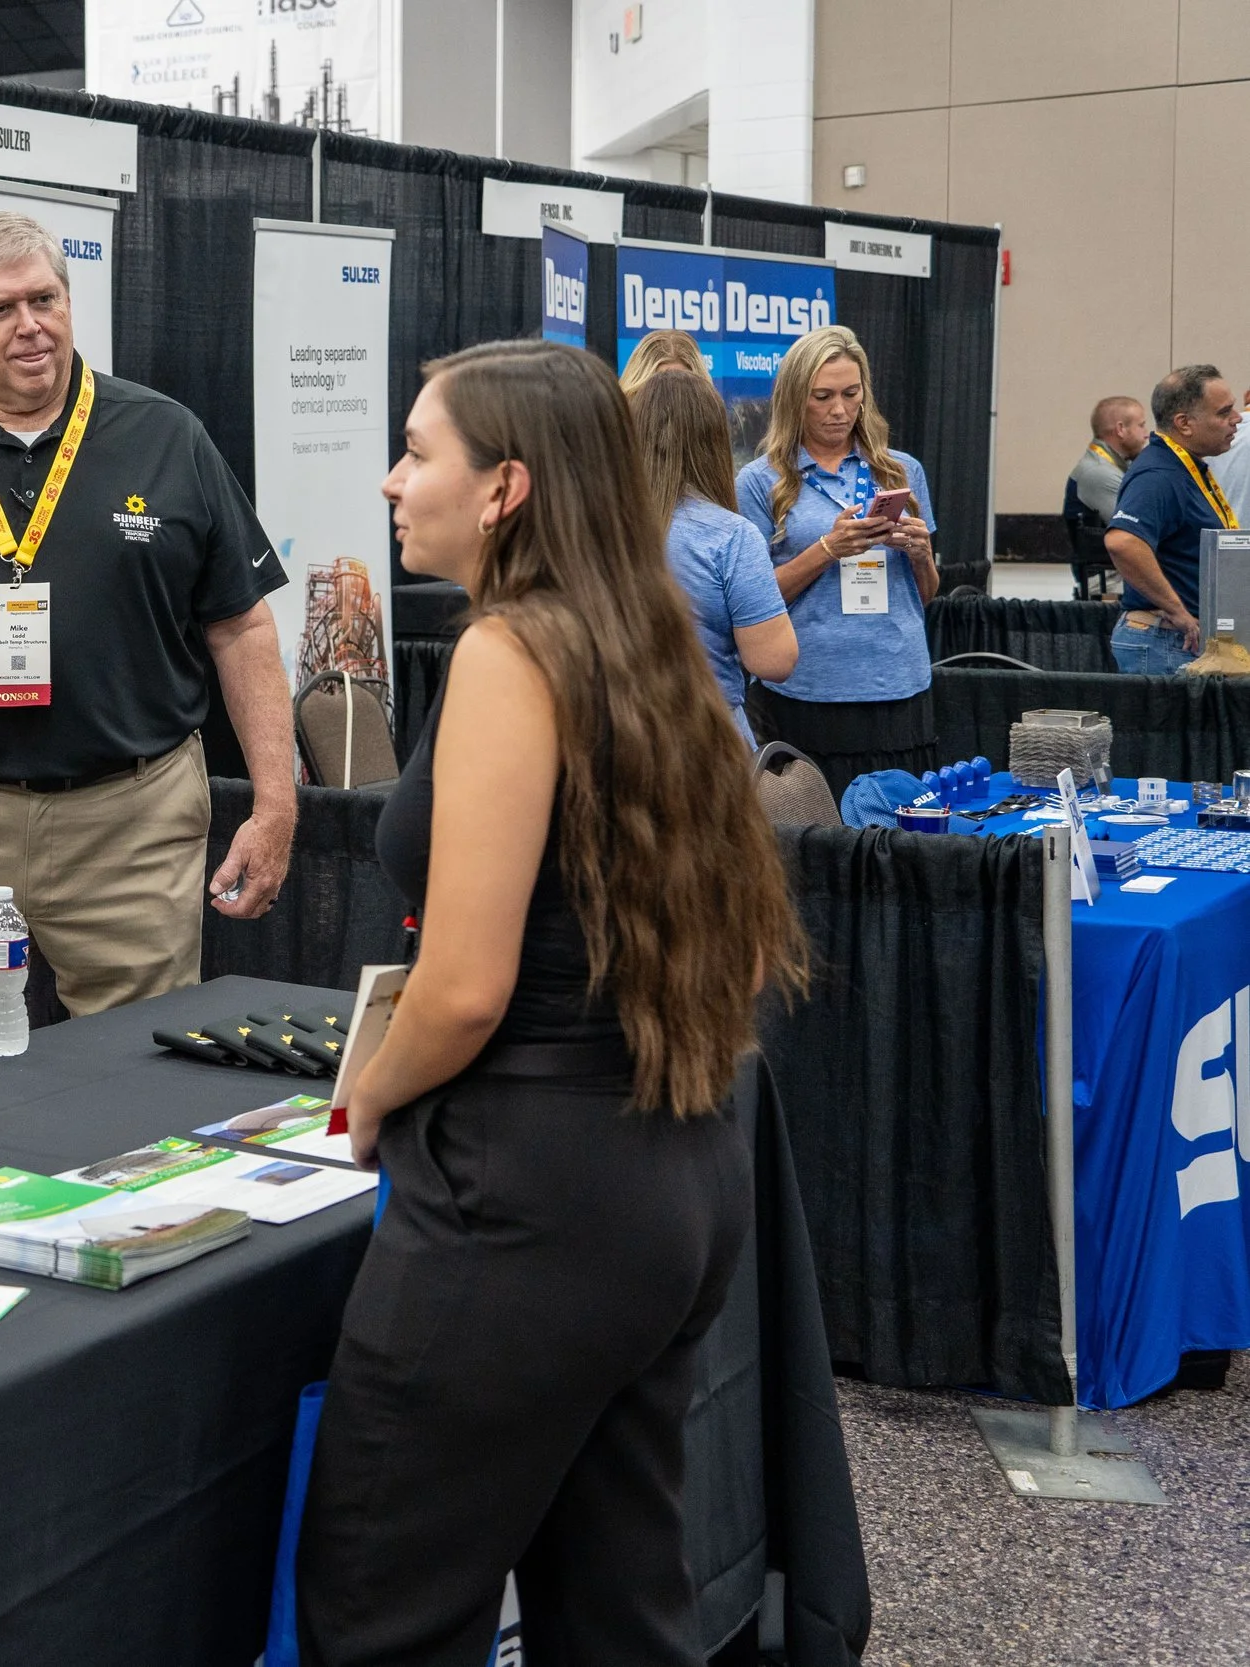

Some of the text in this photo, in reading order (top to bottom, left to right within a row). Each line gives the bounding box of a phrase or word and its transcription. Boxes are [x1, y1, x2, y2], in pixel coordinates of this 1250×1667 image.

[297, 20, 336, 30] COUNCIL
[143, 67, 208, 84] COLLEGE
[62, 238, 103, 261] SULZER
[342, 266, 380, 284] SULZER
[544, 257, 586, 326] Denso
[624, 274, 720, 332] Denso
[725, 281, 831, 336] Denso
[290, 345, 367, 366] Leading separation
[735, 350, 772, 376] Viscotaq
[291, 371, 347, 391] technology for
[291, 396, 367, 416] chemical processing
[62, 446, 74, 462] 3S
[292, 440, 351, 455] Packed or tray column
[46, 486, 59, 503] 3S
[113, 512, 160, 527] SUNBELT
[119, 522, 154, 530] RENTALS
[28, 528, 42, 545] 3S
